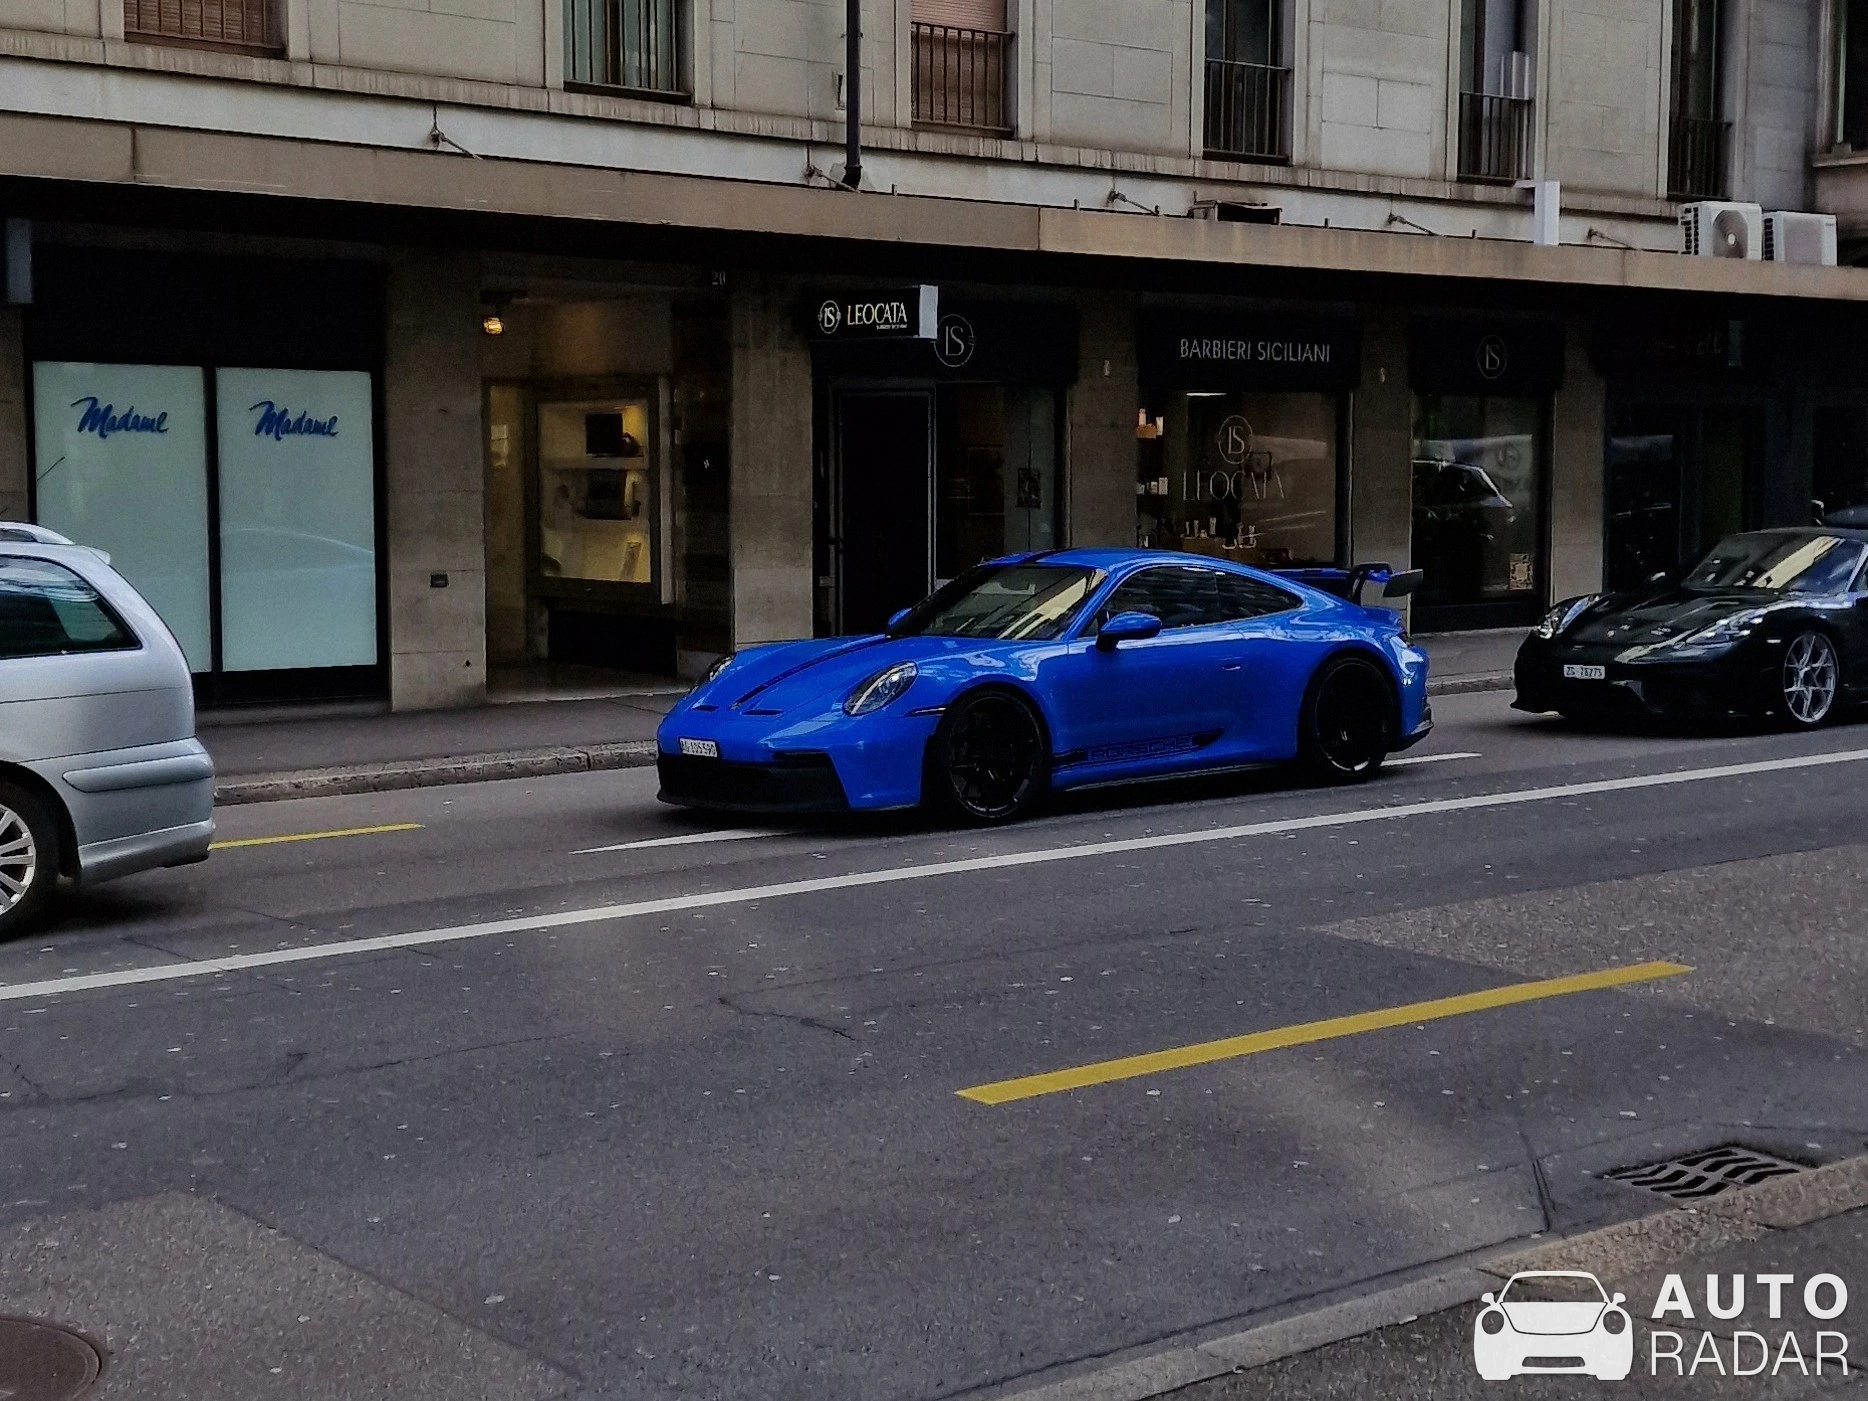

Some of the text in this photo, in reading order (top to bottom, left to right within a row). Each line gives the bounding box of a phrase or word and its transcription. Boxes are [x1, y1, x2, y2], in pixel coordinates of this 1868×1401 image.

[712, 270, 726, 286] 20
[846, 301, 908, 326] LEOCATA
[1179, 337, 1331, 364] BARBIERI SICILIANI
[70, 396, 169, 440] Madame
[249, 400, 339, 442] Madame
